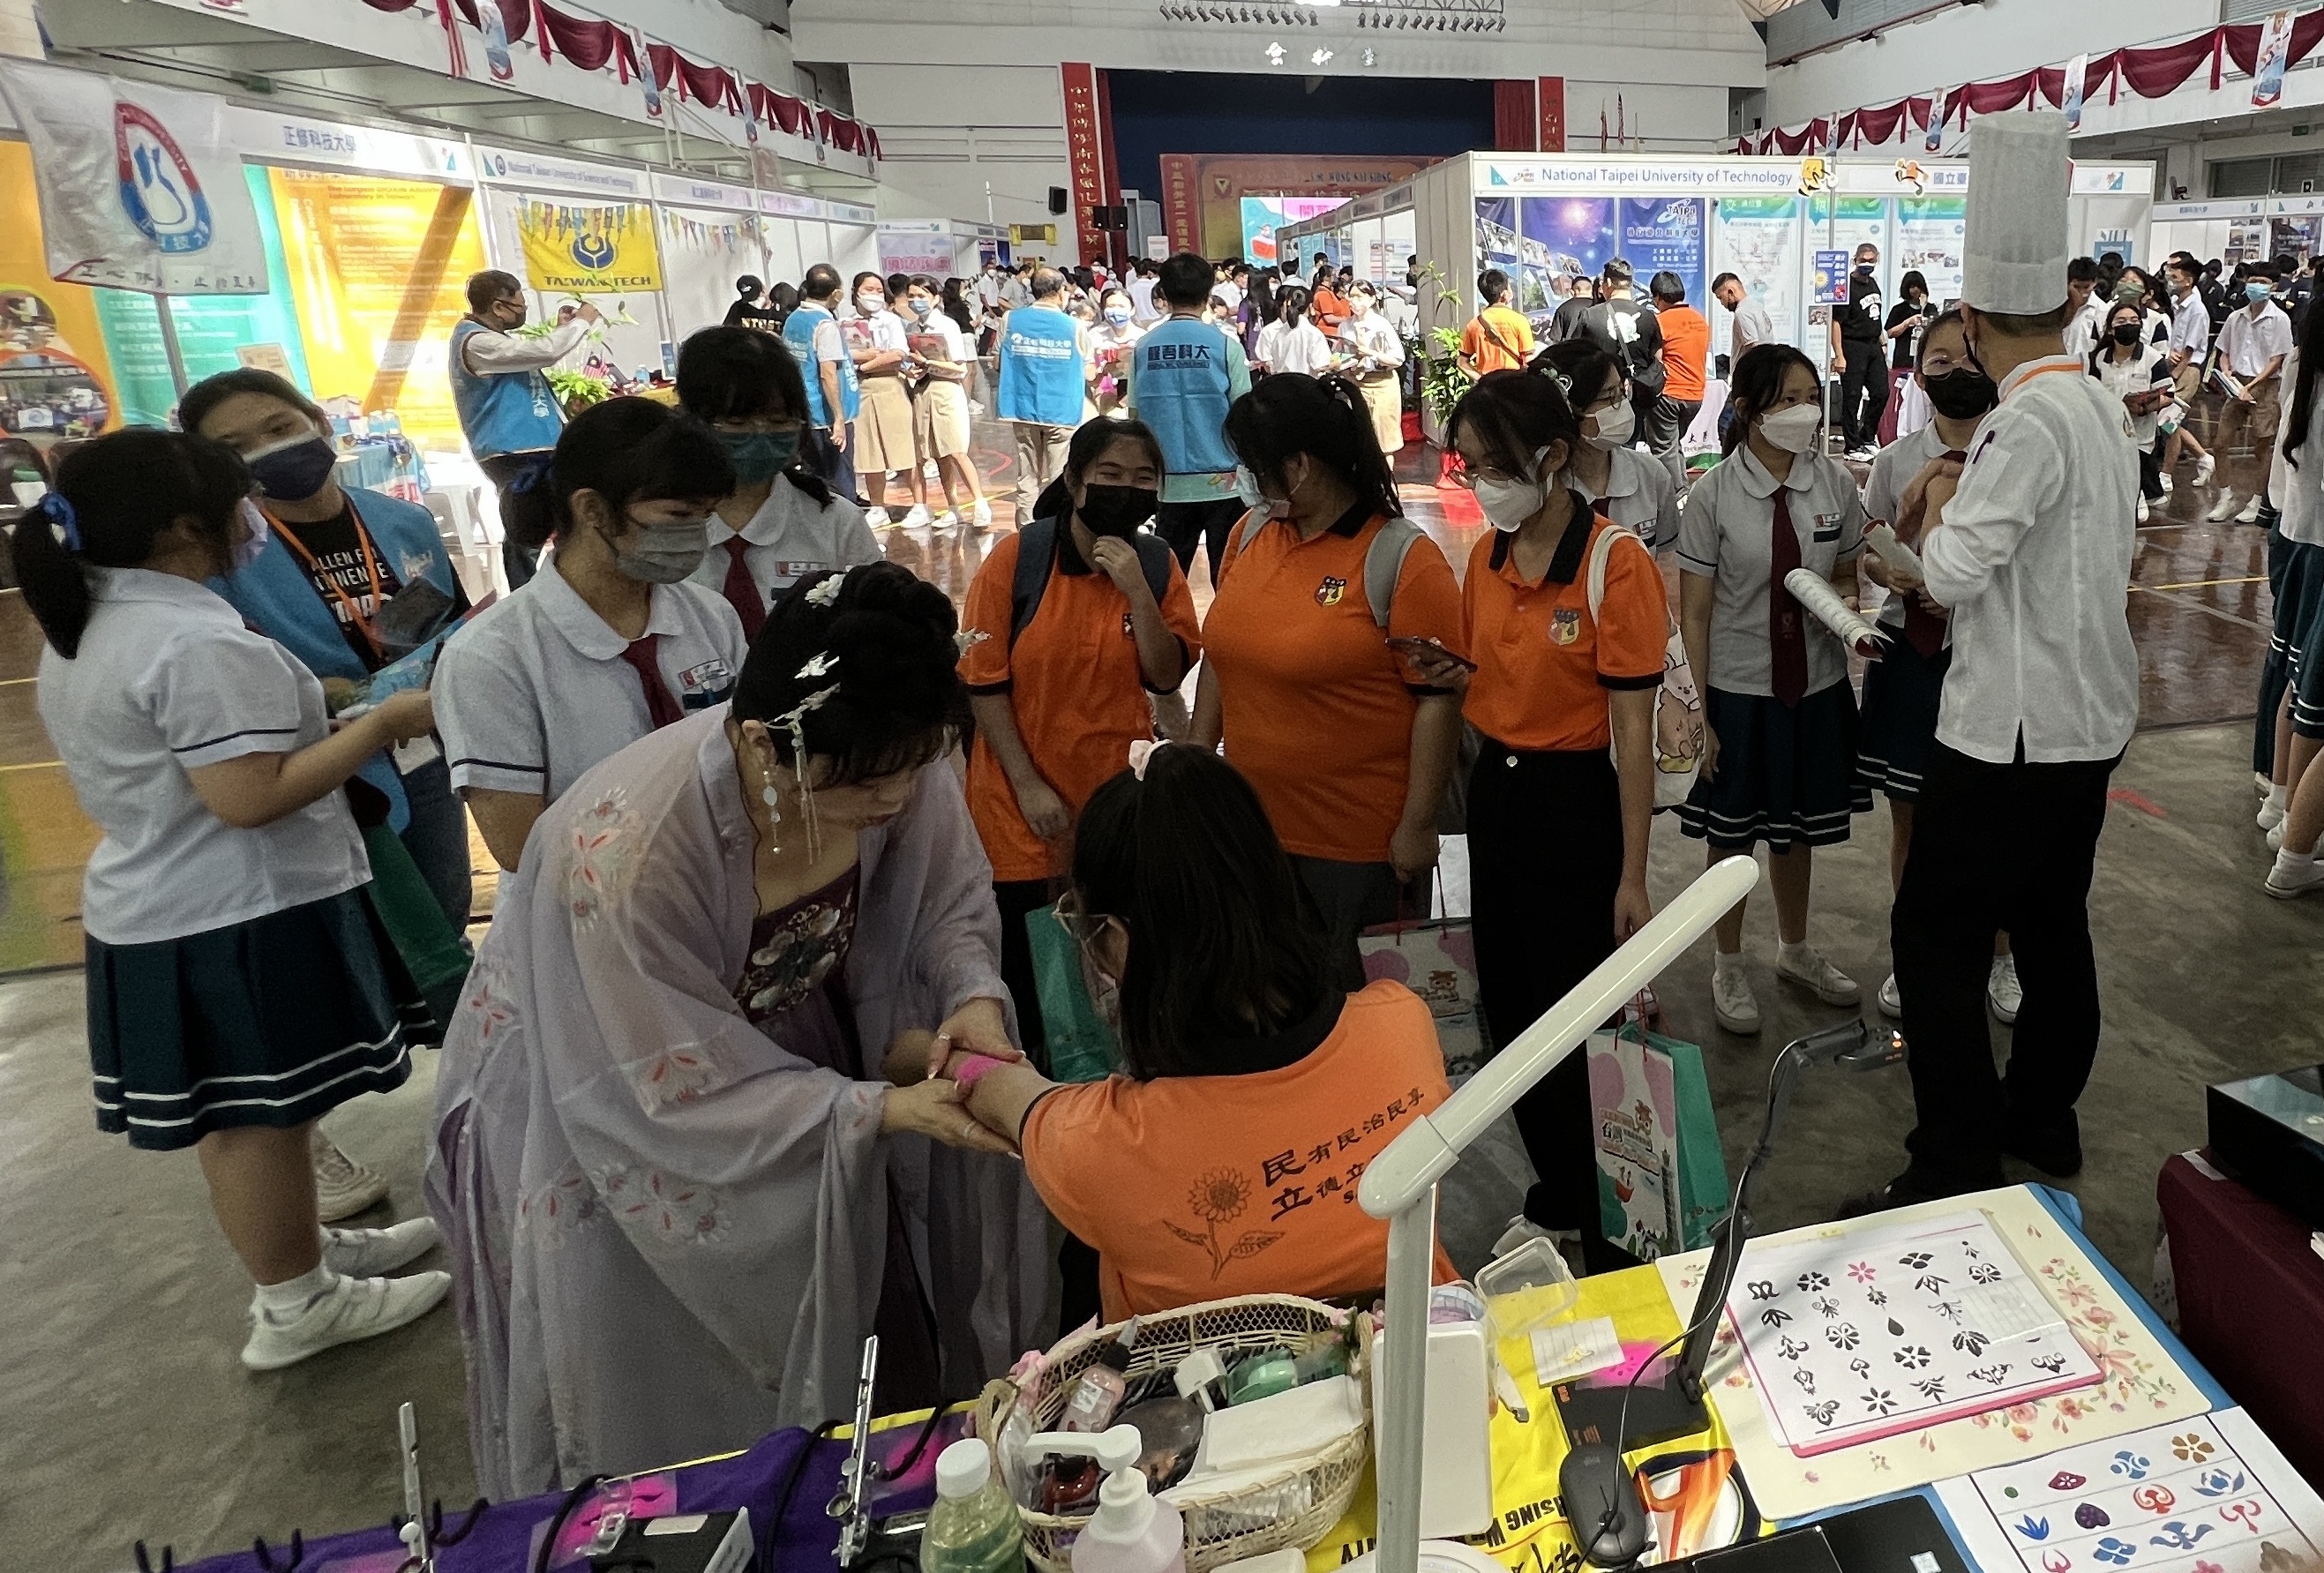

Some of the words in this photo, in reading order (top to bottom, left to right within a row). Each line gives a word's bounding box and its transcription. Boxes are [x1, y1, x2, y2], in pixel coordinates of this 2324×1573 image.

[1542, 169, 1597, 182] National
[1601, 169, 1638, 184] Taipei
[1642, 169, 1704, 185] University
[1706, 169, 1721, 183] of
[1723, 170, 1793, 186] Technology
[618, 275, 651, 286] TECH
[1262, 1087, 1425, 1187] 民有民治民享
